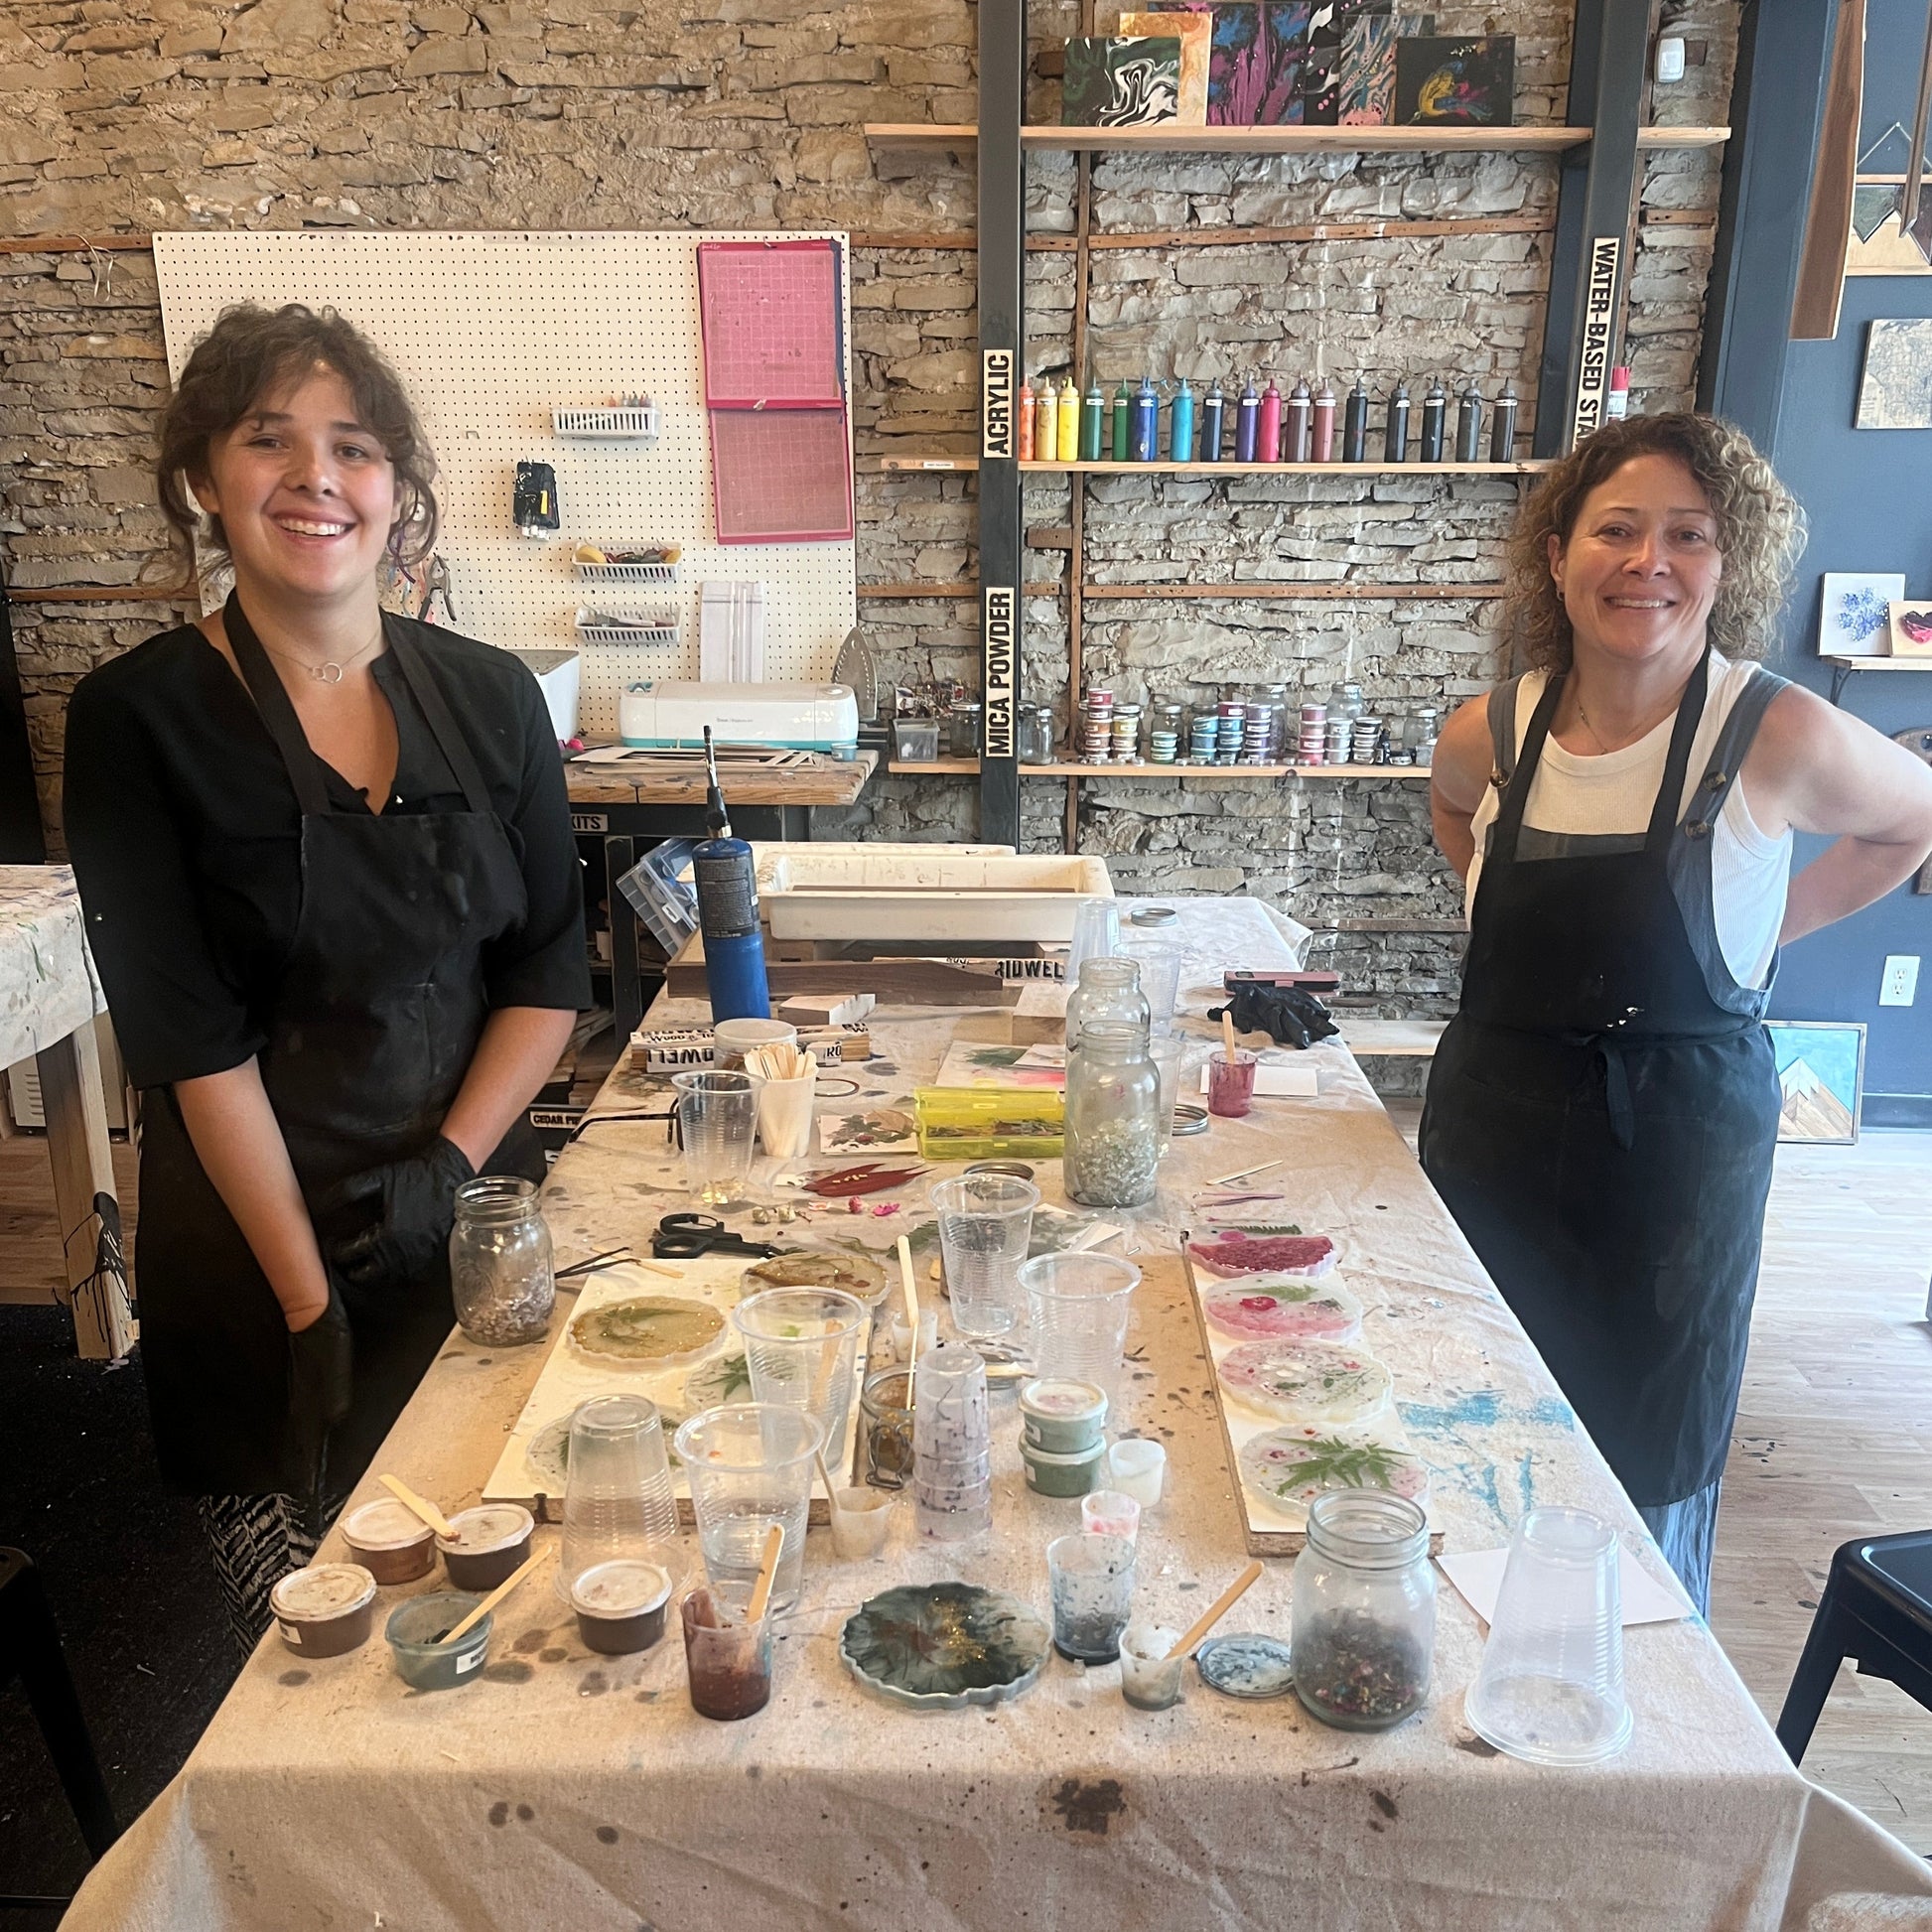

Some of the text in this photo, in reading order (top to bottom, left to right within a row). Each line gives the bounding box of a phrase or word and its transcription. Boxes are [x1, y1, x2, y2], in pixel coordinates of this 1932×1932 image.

[1583, 241, 1616, 390] WATER-BASED
[987, 354, 1010, 456] ACRYLIC
[1576, 398, 1598, 438] STA
[988, 593, 1011, 755] MICA POWDER
[533, 1115, 563, 1125] CEDAR
